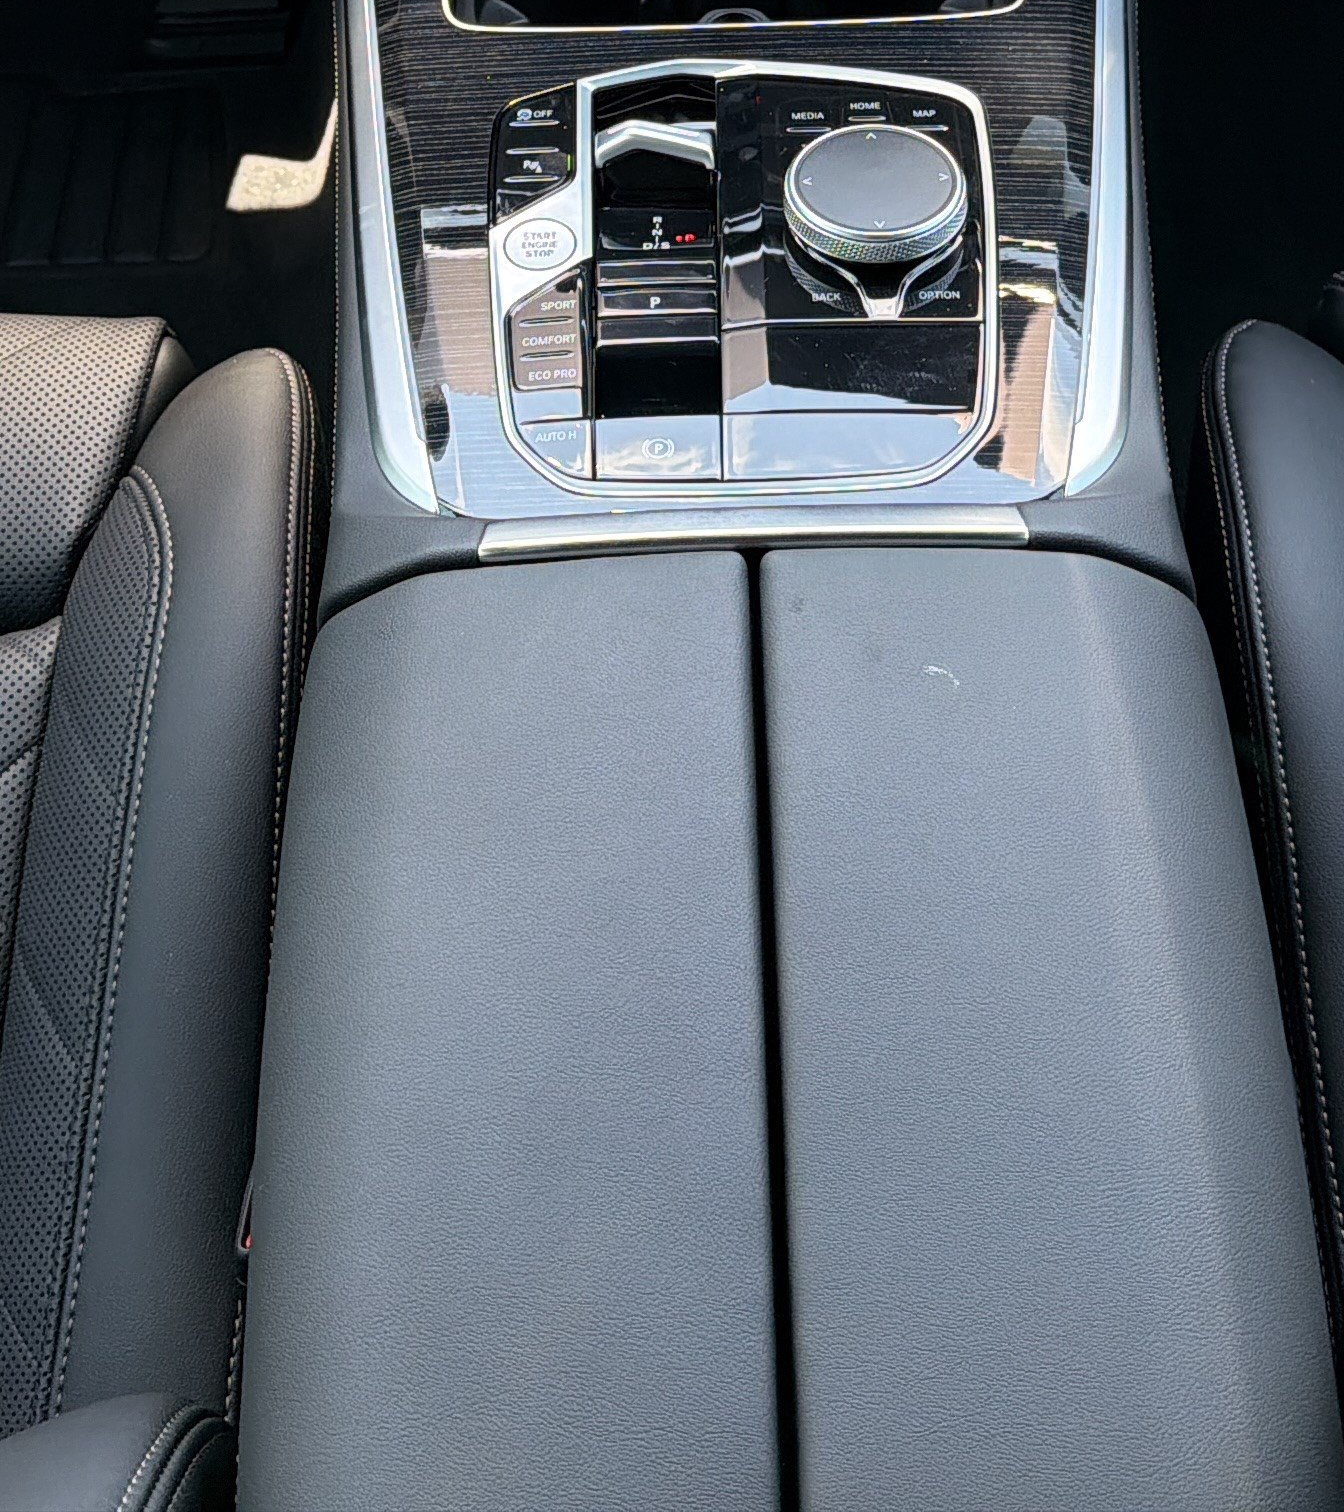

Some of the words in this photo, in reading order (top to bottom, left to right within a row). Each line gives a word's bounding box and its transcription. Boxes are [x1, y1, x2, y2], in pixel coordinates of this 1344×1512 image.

[849, 101, 881, 110] HOME
[533, 109, 554, 118] OFF
[791, 112, 825, 120] MEDIA
[912, 109, 937, 118] MAP
[523, 231, 557, 241] START
[811, 292, 842, 302] BACK
[918, 290, 961, 300] OPTION
[540, 300, 577, 311] SPORT
[649, 296, 661, 309] P
[522, 334, 577, 347] COMFORT
[528, 369, 551, 381] ECO
[553, 368, 577, 380] PRO
[535, 431, 566, 443] AUTO
[568, 430, 577, 440] H
